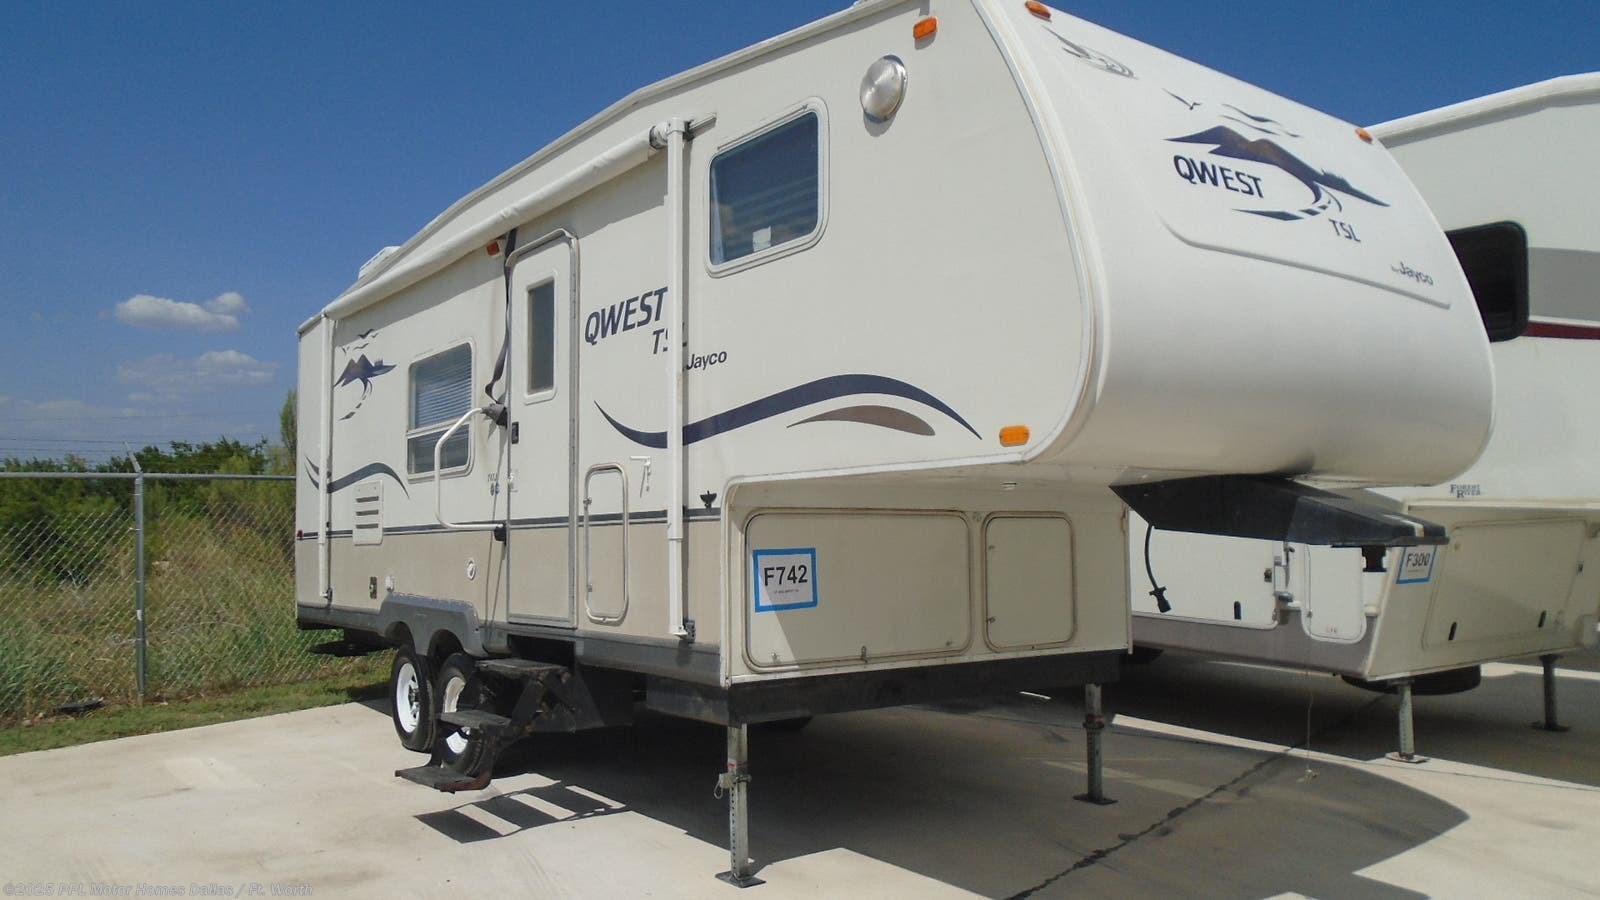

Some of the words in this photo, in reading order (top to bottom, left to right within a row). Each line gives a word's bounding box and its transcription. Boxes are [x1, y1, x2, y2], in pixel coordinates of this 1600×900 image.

[1173, 155, 1264, 198] QWEST
[1328, 218, 1362, 243] TSL
[1400, 261, 1434, 286] Jayco
[584, 286, 669, 346] QWEST
[686, 351, 727, 371] Jayco
[1406, 552, 1431, 567] F300
[763, 564, 808, 586] F742
